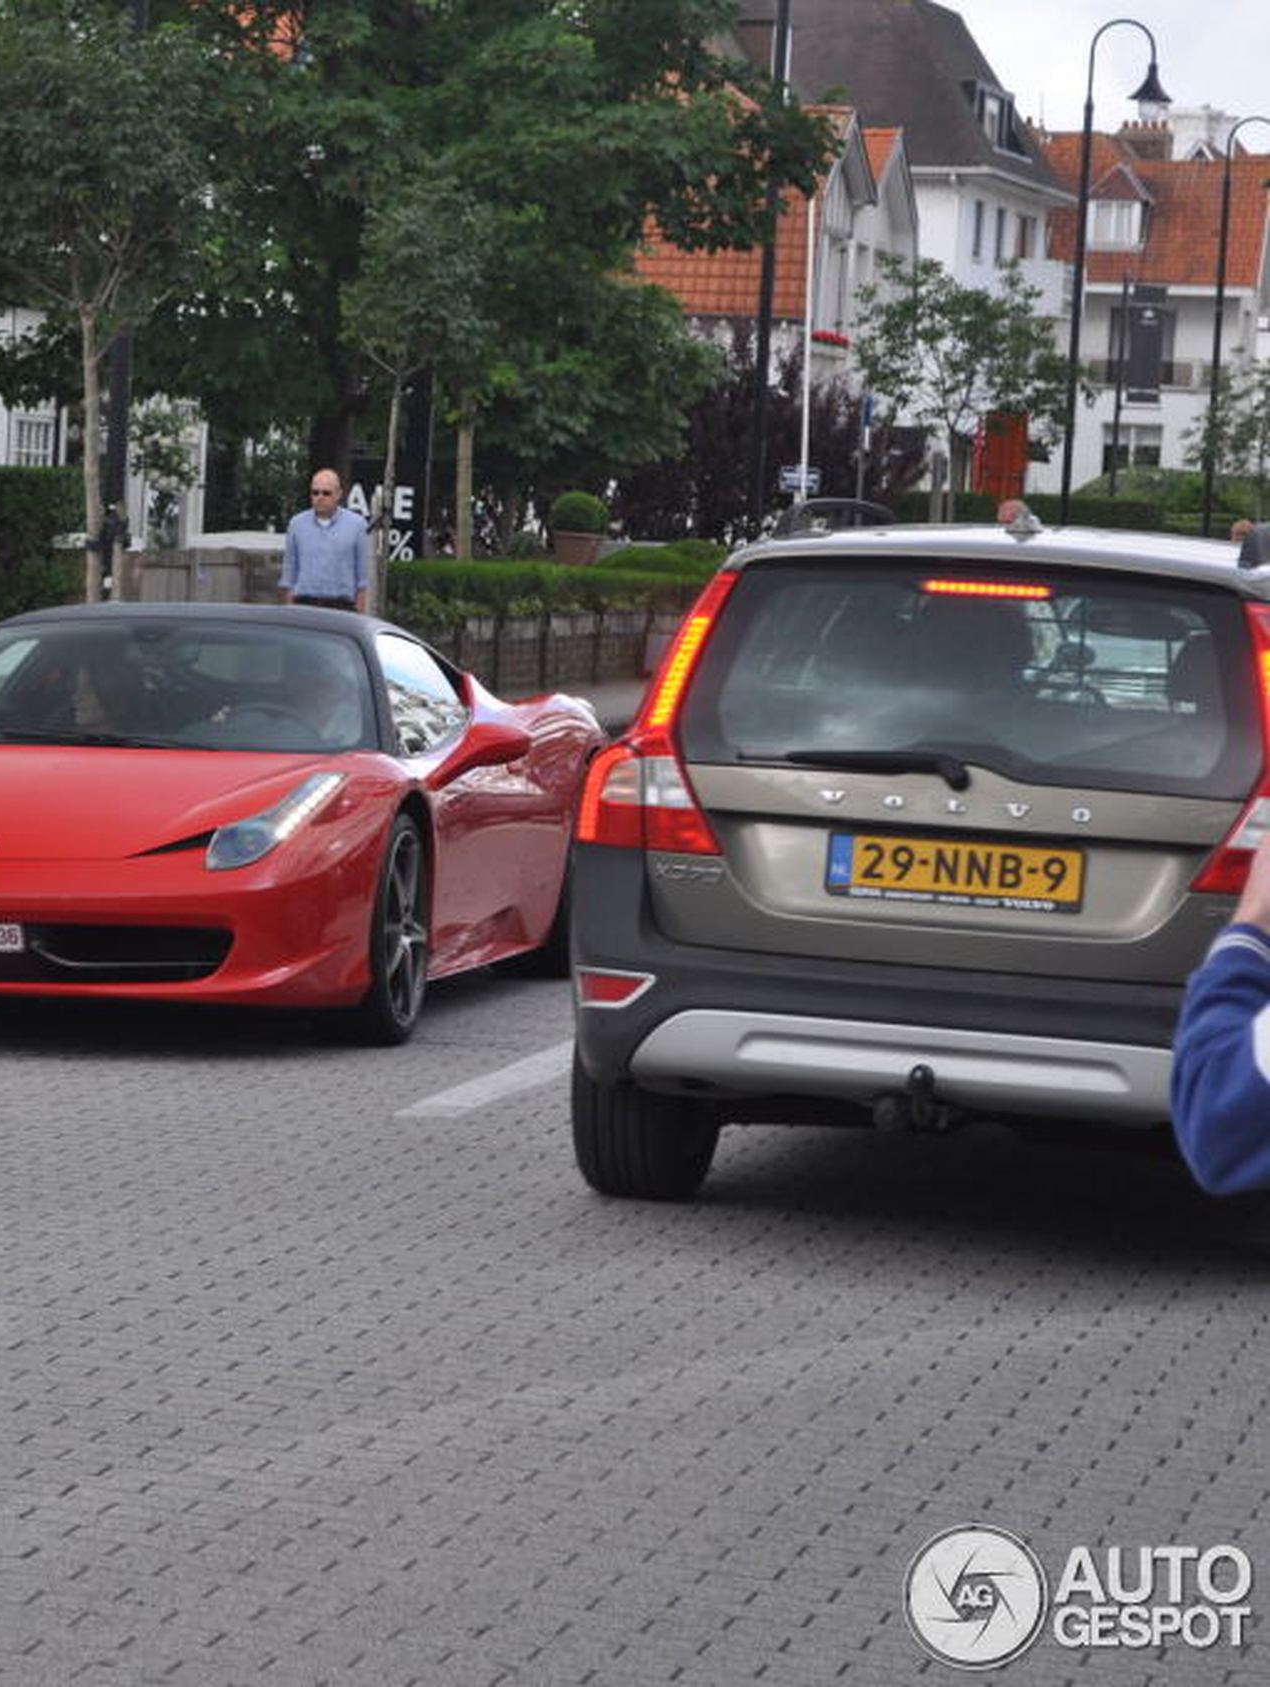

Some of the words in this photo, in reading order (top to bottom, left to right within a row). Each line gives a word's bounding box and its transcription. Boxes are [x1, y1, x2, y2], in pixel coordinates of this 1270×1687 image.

[819, 789, 1093, 824] VOLVO
[861, 842, 1068, 893] 29-NNB-9
[1002, 896, 1056, 911] VOLVO
